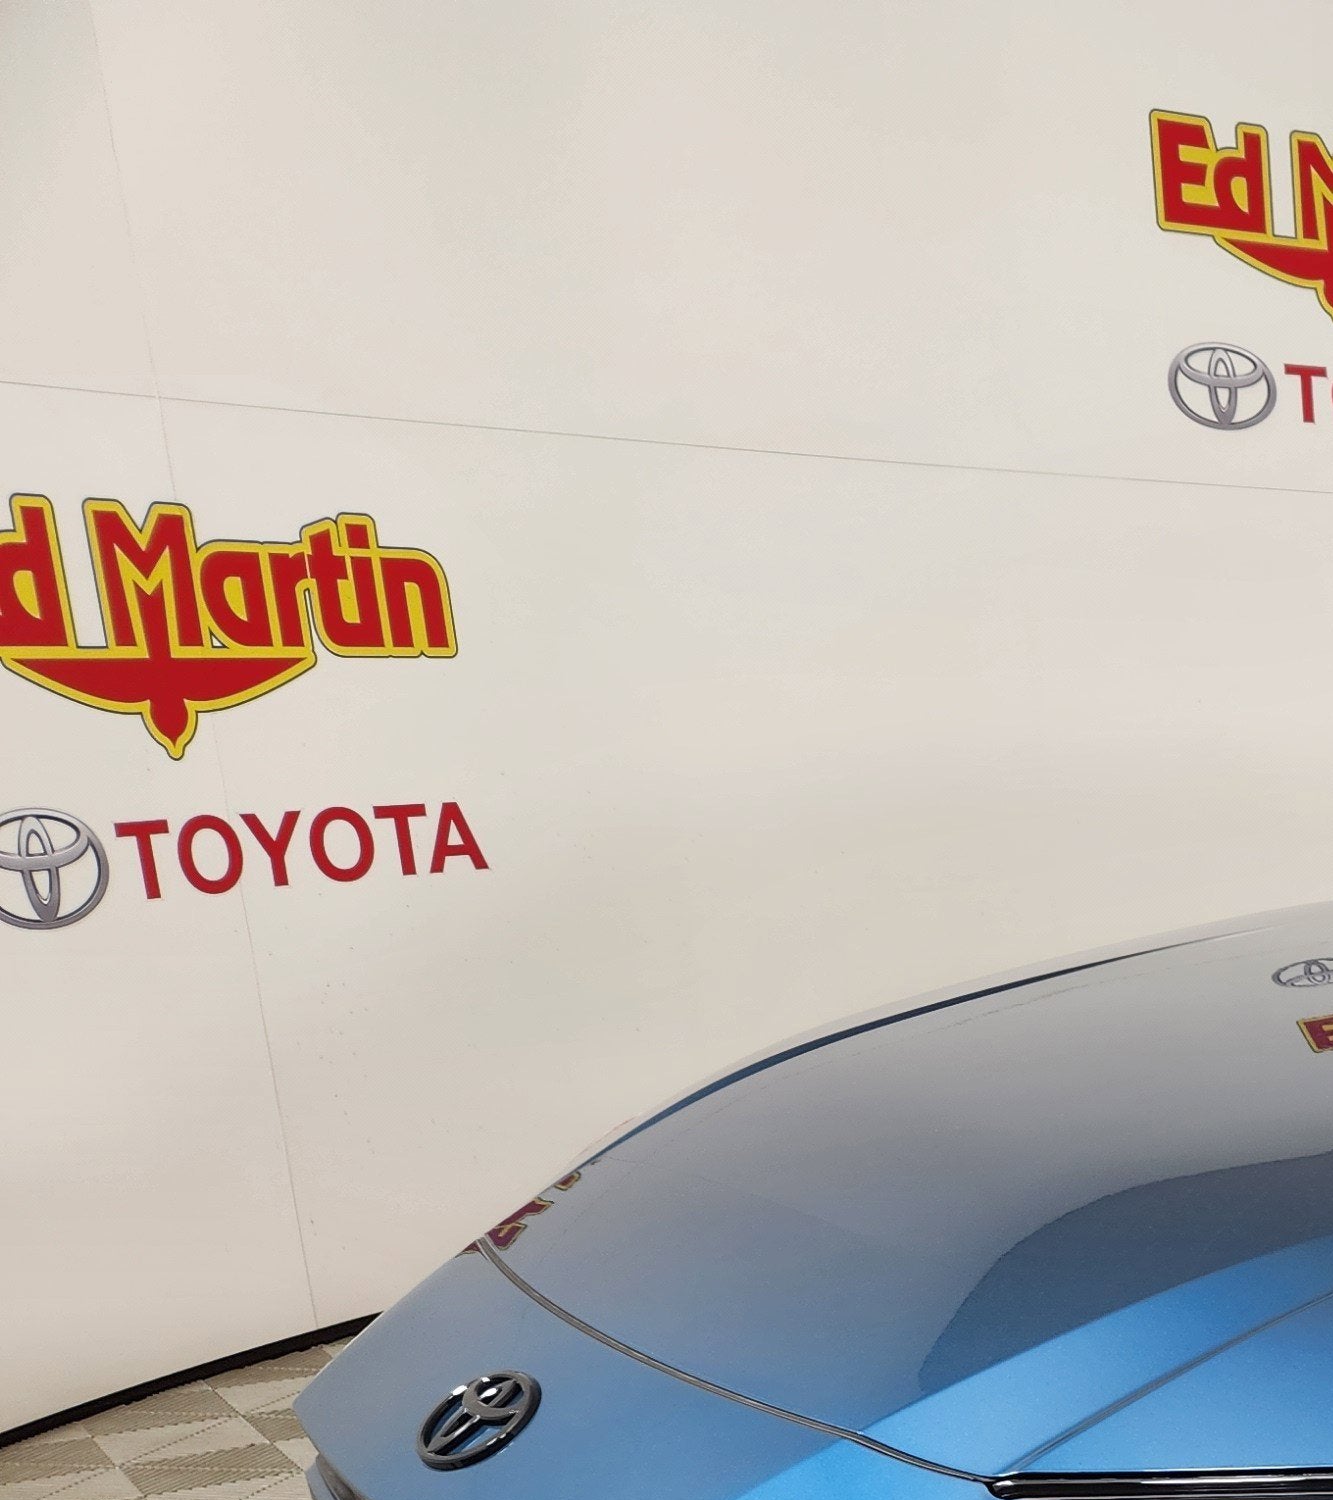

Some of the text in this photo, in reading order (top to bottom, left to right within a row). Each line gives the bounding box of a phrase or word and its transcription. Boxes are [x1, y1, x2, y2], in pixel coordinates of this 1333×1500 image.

[1151, 111, 1271, 236] Ed
[0, 496, 456, 656] d Martin
[114, 801, 489, 900] TOYOTA
